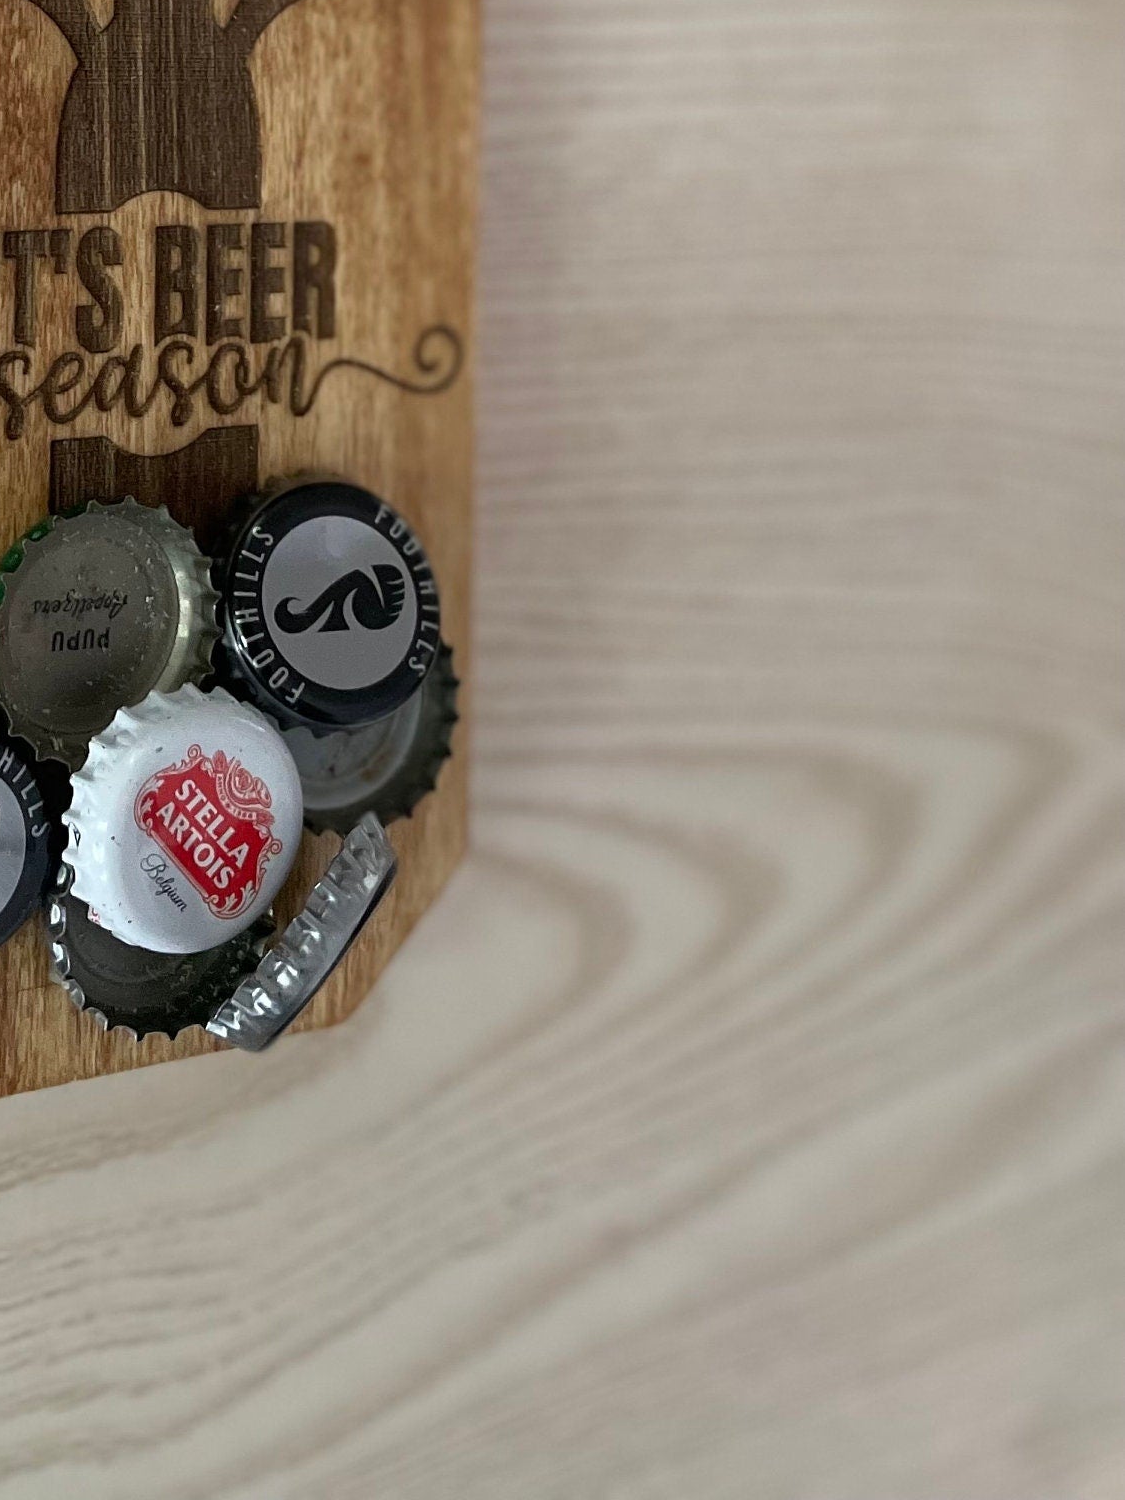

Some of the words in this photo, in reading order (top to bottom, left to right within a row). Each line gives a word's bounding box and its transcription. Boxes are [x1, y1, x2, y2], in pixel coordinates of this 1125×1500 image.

[154, 220, 337, 346] BEER
[234, 525, 306, 704] FOOTHILLS
[375, 503, 437, 678] FOOTHILLS
[51, 627, 110, 652] PUPU
[156, 801, 236, 889] ARTOIS
[175, 779, 249, 869] STELLA
[140, 853, 187, 912] Belgium
